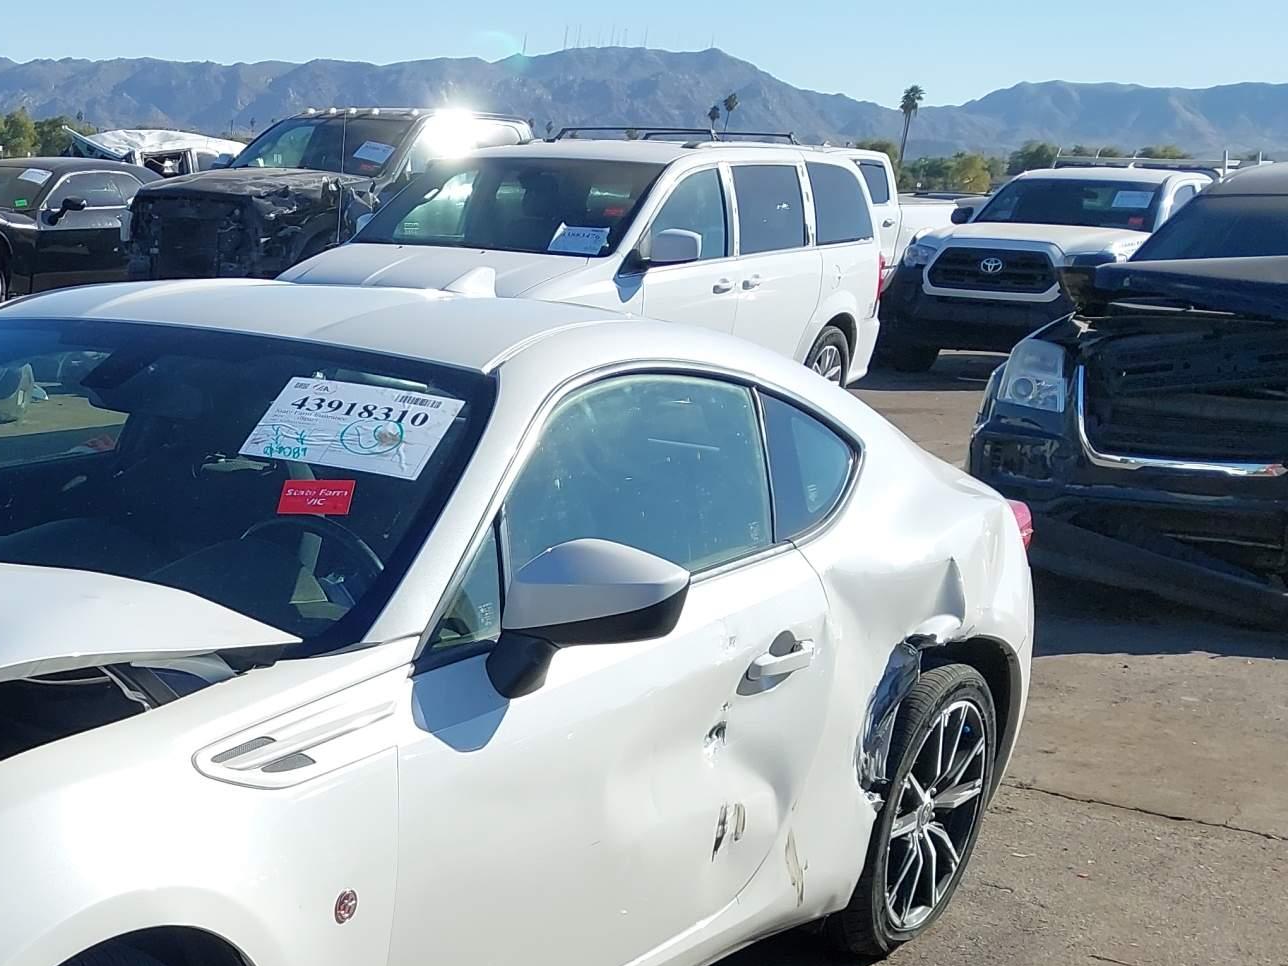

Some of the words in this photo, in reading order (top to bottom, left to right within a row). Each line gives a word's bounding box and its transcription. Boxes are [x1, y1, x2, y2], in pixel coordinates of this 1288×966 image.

[291, 395, 429, 427] 43918310
[285, 488, 316, 497] State
[318, 488, 349, 497] Farm
